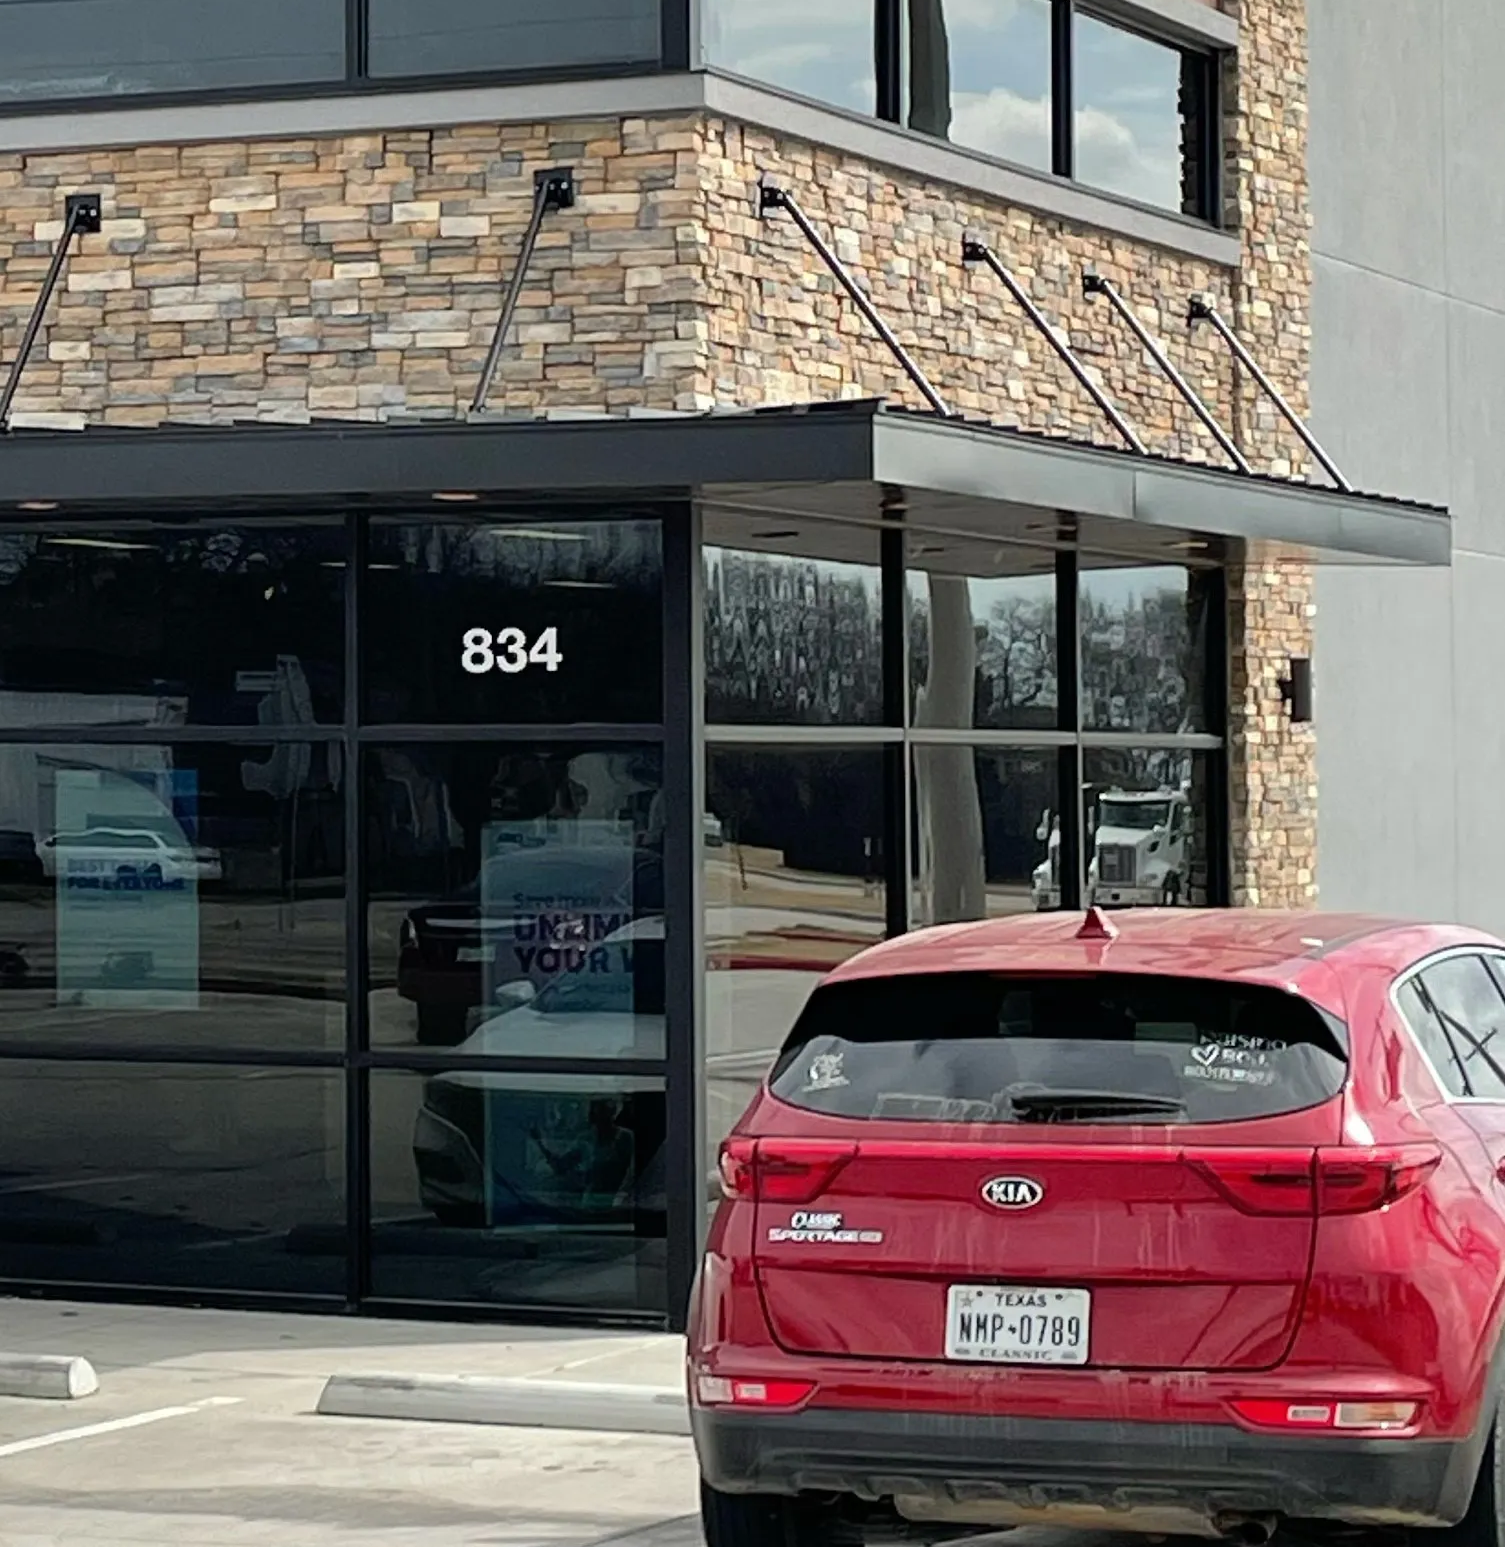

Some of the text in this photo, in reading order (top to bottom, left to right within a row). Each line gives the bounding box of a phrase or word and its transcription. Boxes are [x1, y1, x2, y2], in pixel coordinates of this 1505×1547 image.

[461, 626, 563, 673] 834
[512, 946, 612, 974] YOUR
[991, 1182, 1032, 1203] KIA
[995, 1292, 1048, 1308] TEXAS
